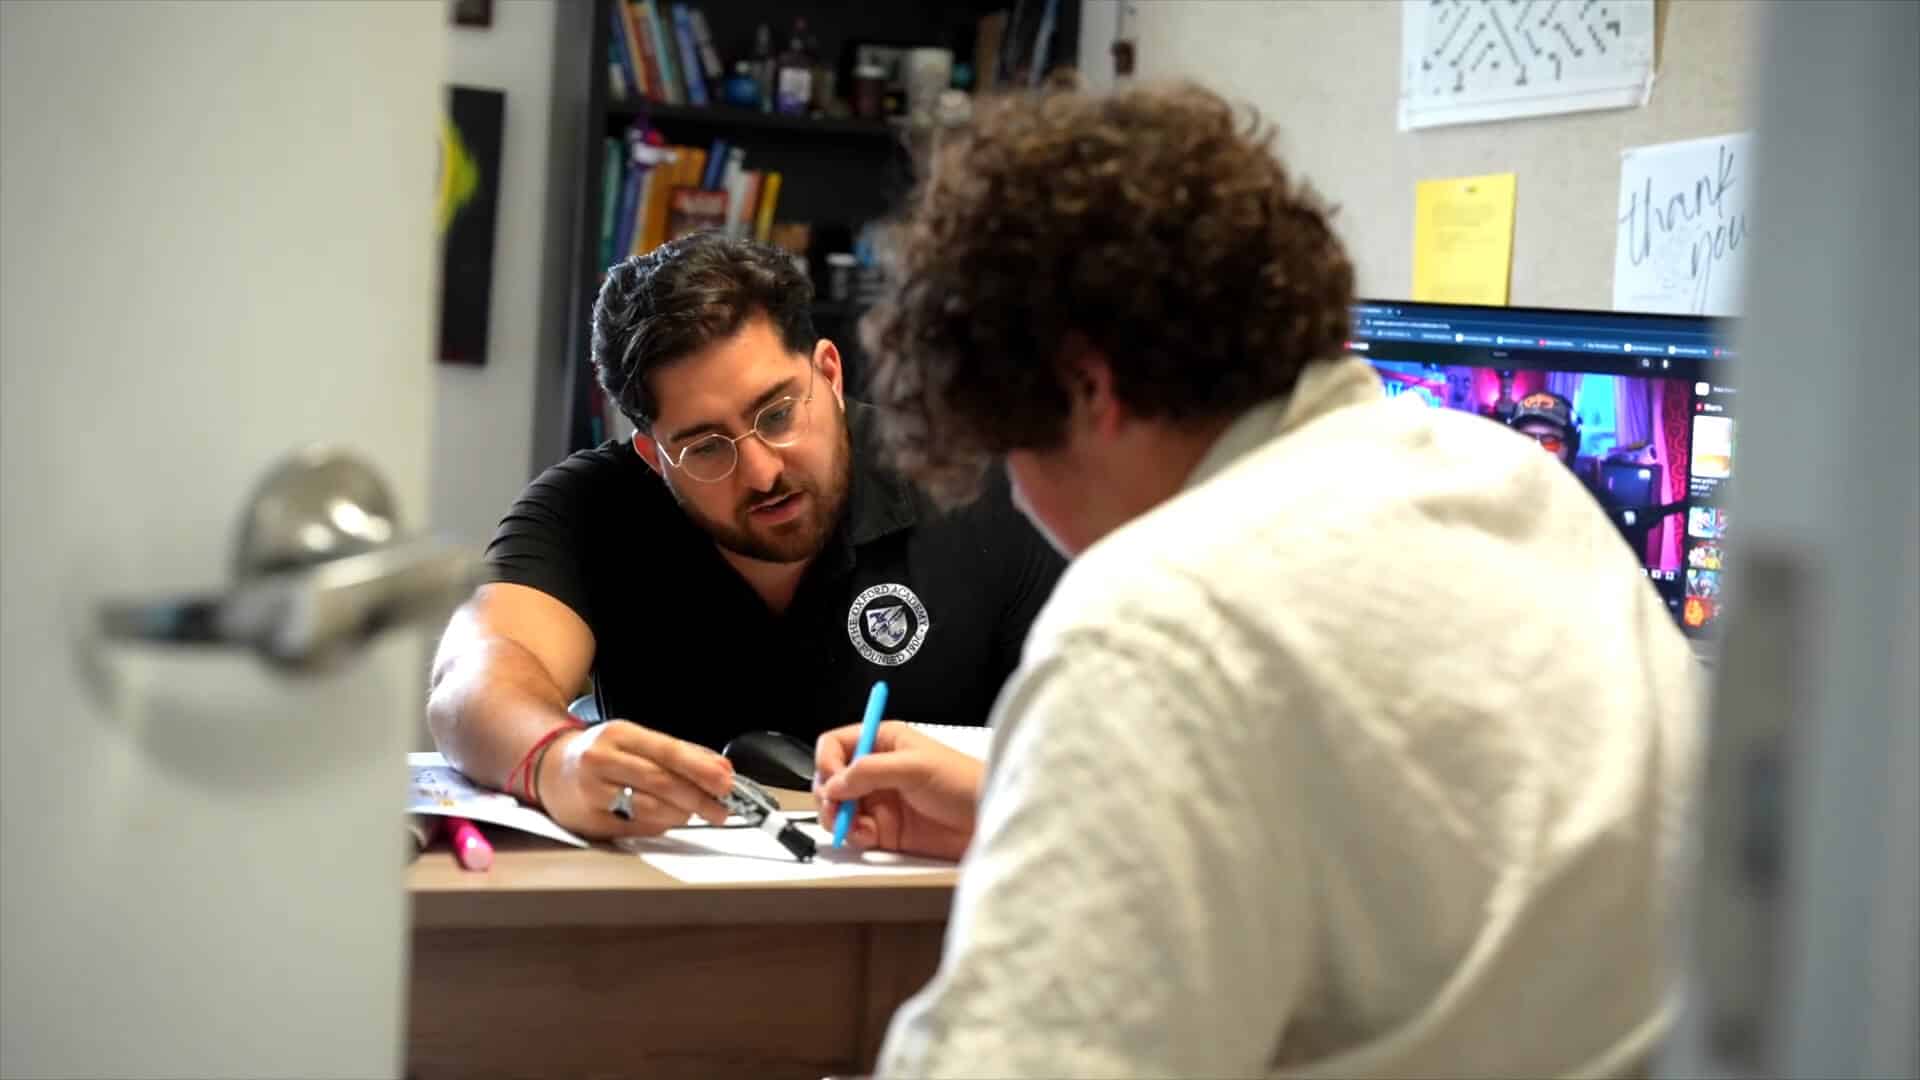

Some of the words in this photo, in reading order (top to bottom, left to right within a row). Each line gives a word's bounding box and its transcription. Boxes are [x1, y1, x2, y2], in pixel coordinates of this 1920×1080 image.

[1617, 144, 1736, 267] thank
[1690, 214, 1749, 315] you
[851, 585, 889, 616] OXFORD
[891, 586, 928, 627] ACADEMY
[849, 616, 859, 642] THE
